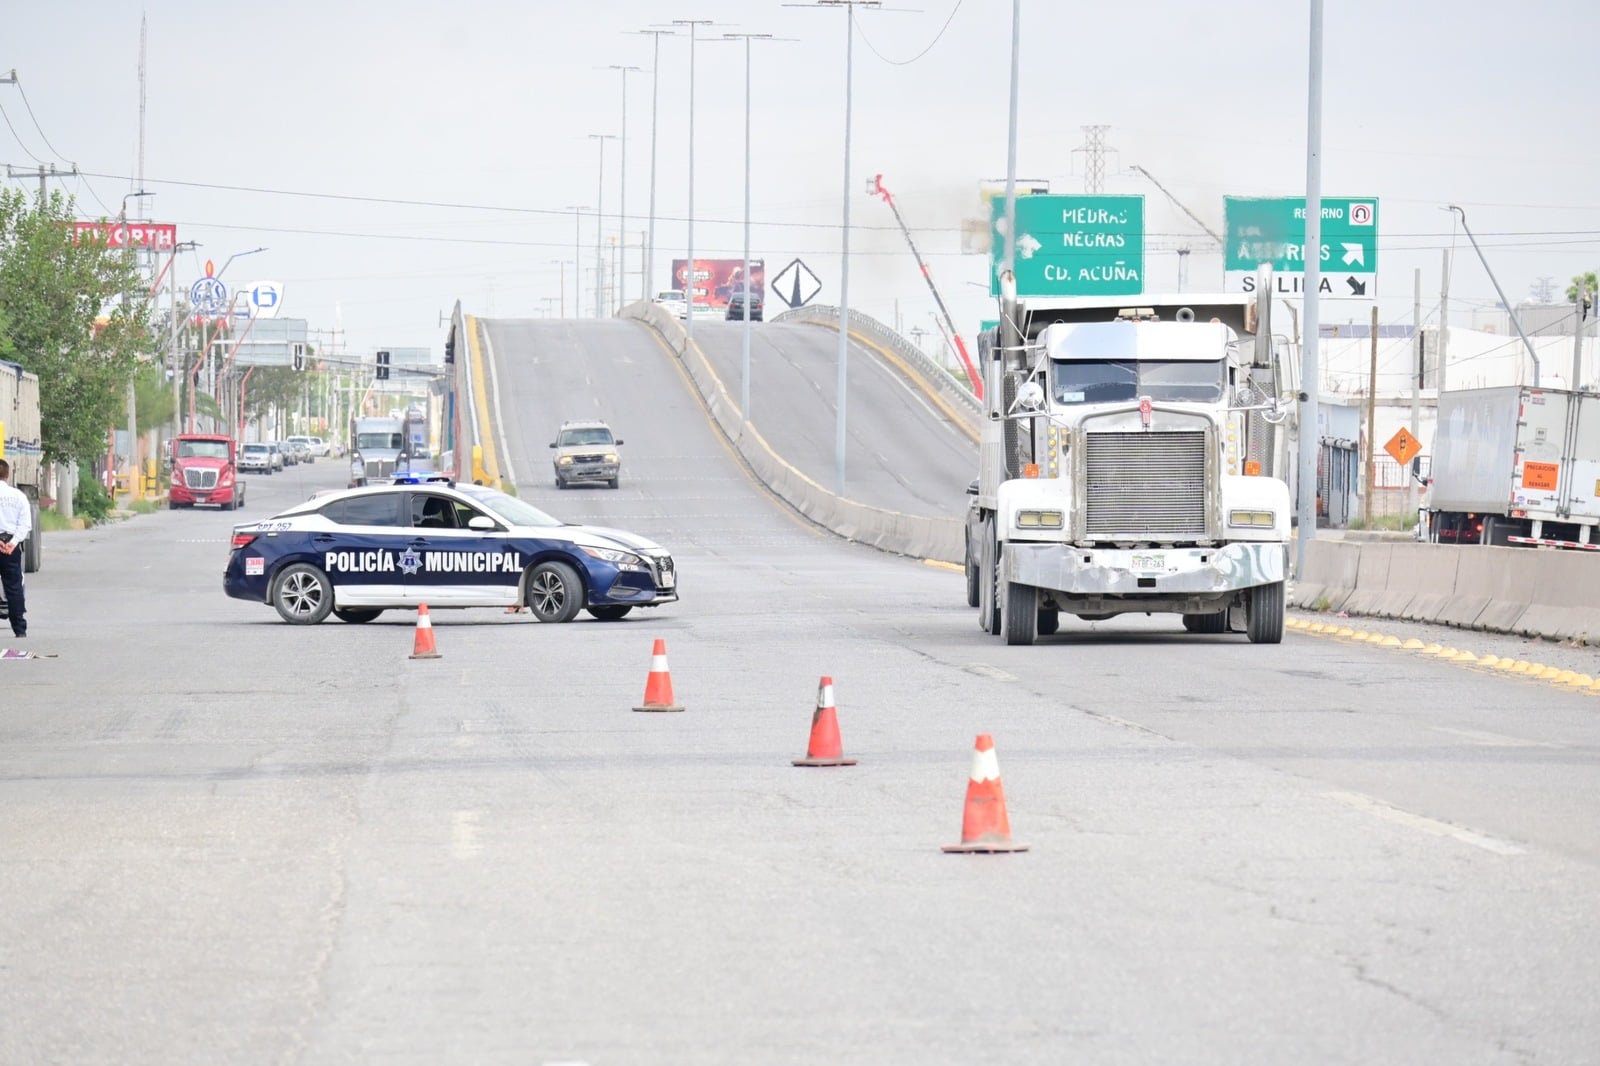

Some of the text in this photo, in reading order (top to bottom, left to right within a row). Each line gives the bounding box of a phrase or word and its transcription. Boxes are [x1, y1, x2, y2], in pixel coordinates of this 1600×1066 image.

[1294, 208, 1343, 219] RERNO
[1063, 230, 1125, 247] NEGRAS
[1078, 260, 1139, 281] ACUÑA
[1242, 277, 1332, 293] SLIA
[325, 548, 524, 573] POLICÍA MUNICIPAL
